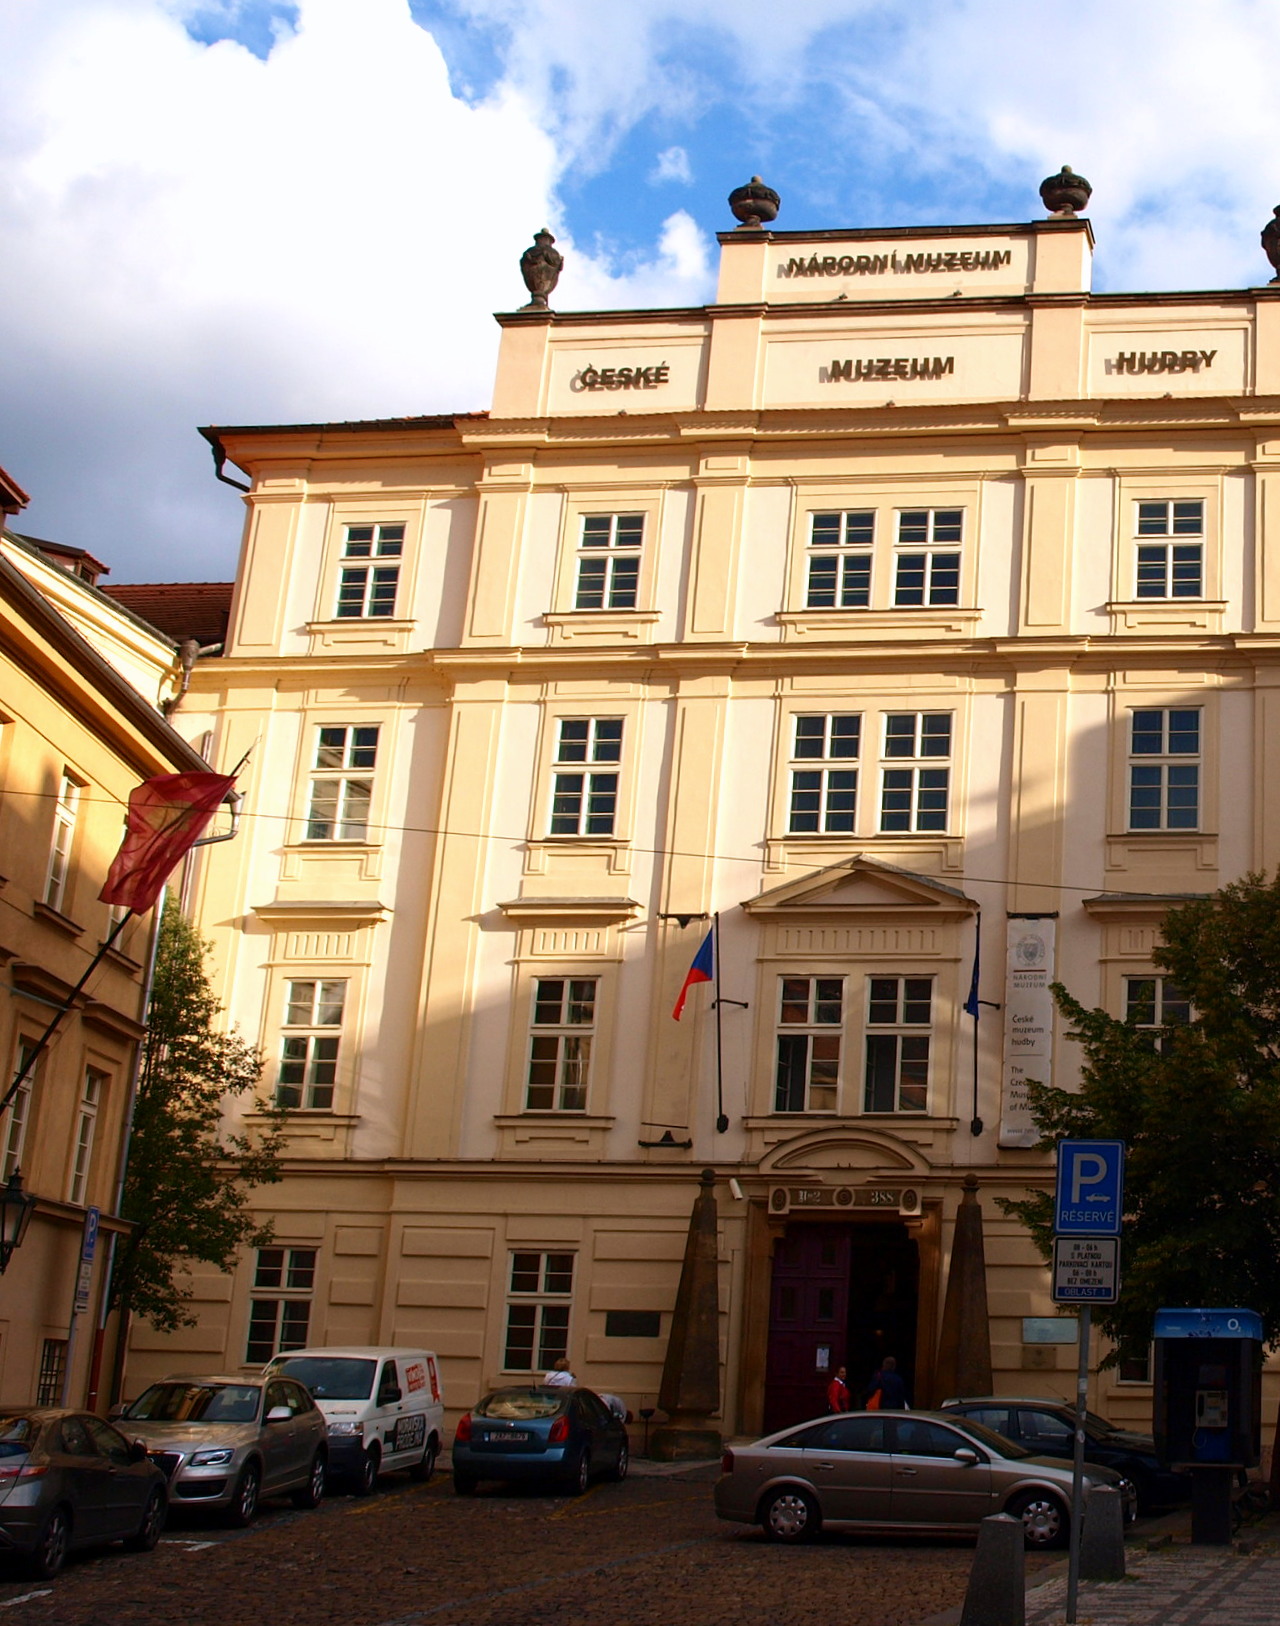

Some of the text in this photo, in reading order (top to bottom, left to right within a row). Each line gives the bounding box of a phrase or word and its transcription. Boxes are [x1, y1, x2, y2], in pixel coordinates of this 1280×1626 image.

[788, 249, 1012, 273] NÁRODNÍ MUZEUM
[580, 350, 1218, 387] ČESKÉ MUZEUM HUDBY
[1012, 1013, 1034, 1024] České
[1012, 1026, 1044, 1034] muzeum
[1011, 1037, 1036, 1047] hudby
[1010, 1065, 1024, 1074] The
[1009, 1101, 1018, 1110] of
[1070, 1152, 1108, 1204] P
[871, 1190, 894, 1204] 388
[1060, 1209, 1115, 1223] RÉSERVÉ
[1064, 1288, 1097, 1296] OBLAST
